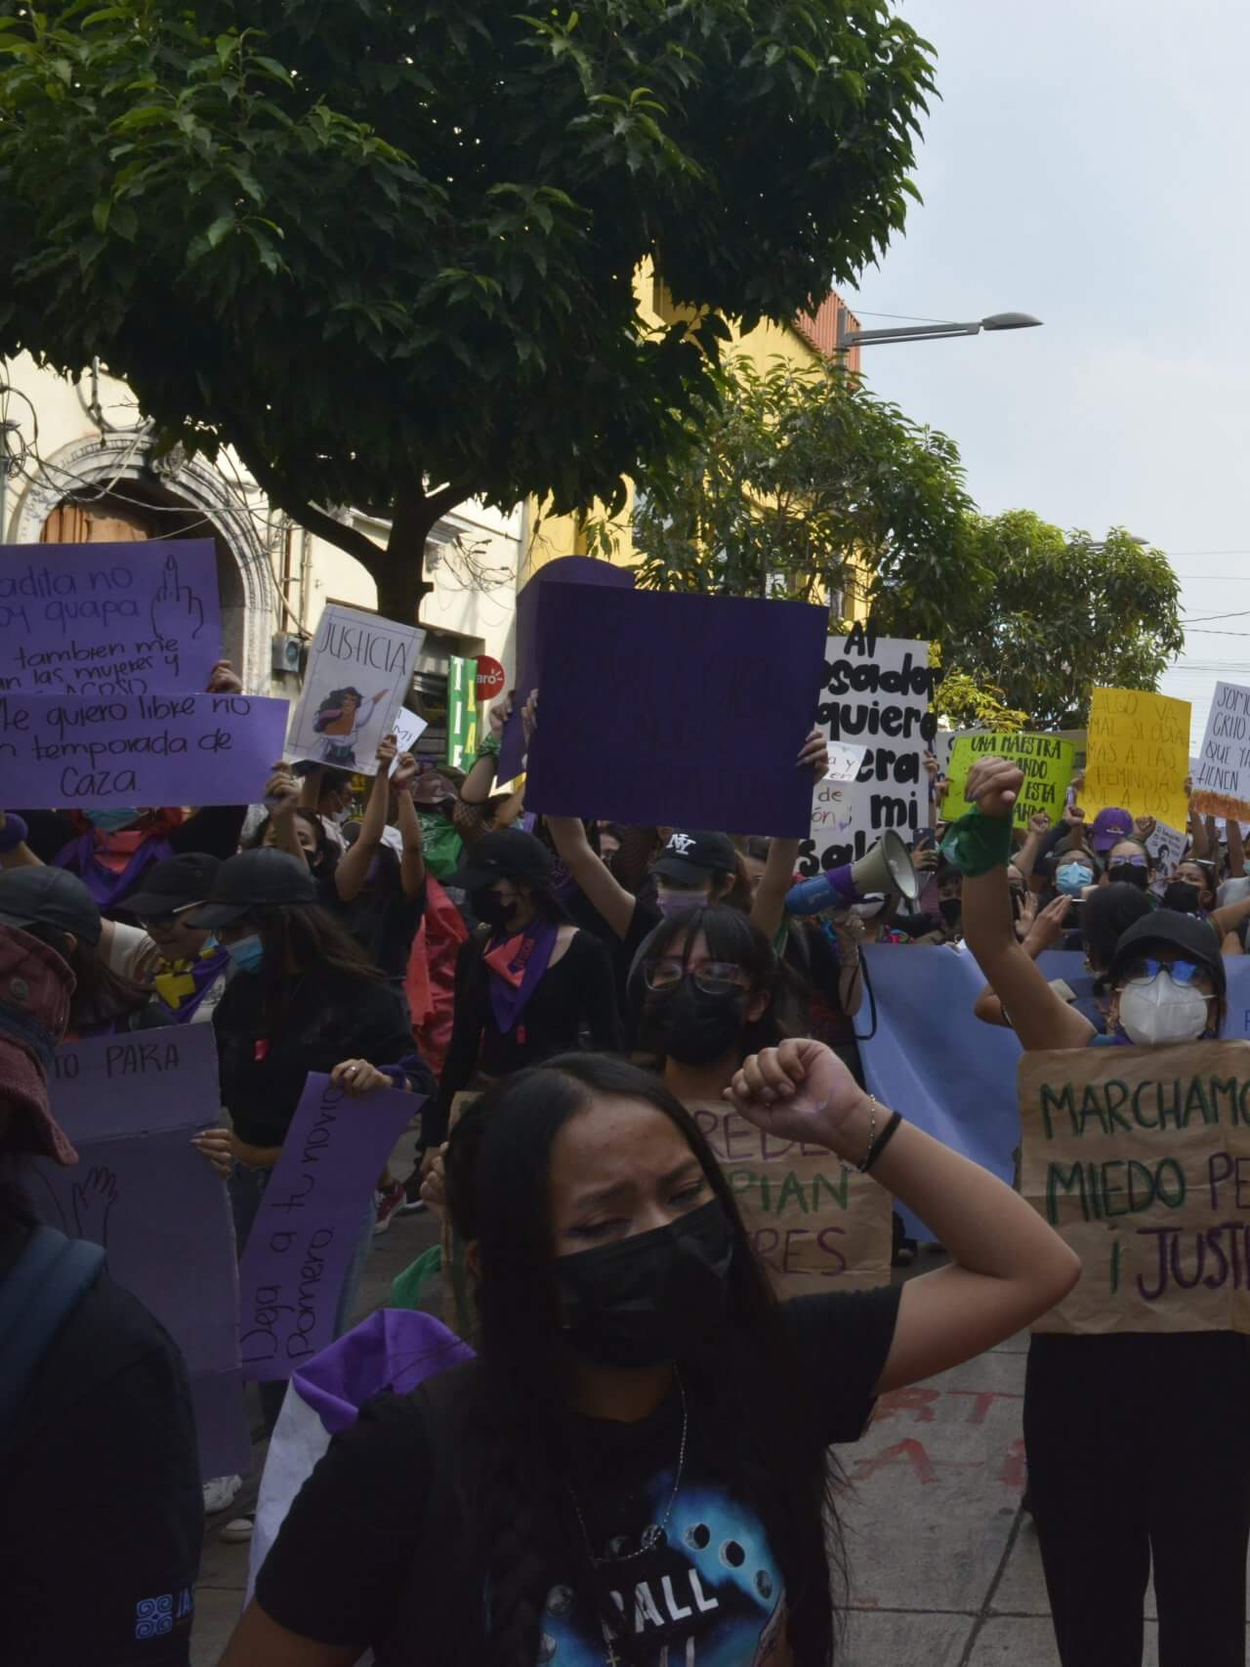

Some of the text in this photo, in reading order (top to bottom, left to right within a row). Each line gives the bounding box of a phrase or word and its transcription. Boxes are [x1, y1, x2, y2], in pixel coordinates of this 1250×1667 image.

[88, 567, 133, 590] no
[135, 638, 179, 655] me
[316, 622, 407, 676] JUSTICIA
[844, 622, 876, 658] Al
[33, 668, 63, 685] las
[47, 702, 127, 739] quiero
[140, 696, 195, 720] libre
[1089, 718, 1122, 737] MAL
[32, 731, 188, 769] temporada
[199, 728, 233, 751] de
[971, 736, 1062, 759] UNA MAESTRA
[1147, 747, 1177, 769] LAS
[1205, 740, 1231, 764] QUE
[818, 787, 842, 802] de
[870, 791, 918, 829] mi
[666, 833, 696, 855] NY
[106, 1043, 180, 1078] PARA
[271, 1173, 315, 1214] tu
[1045, 1156, 1187, 1225] MIEDO
[270, 1231, 297, 1255] a
[239, 1285, 295, 1363] Deja
